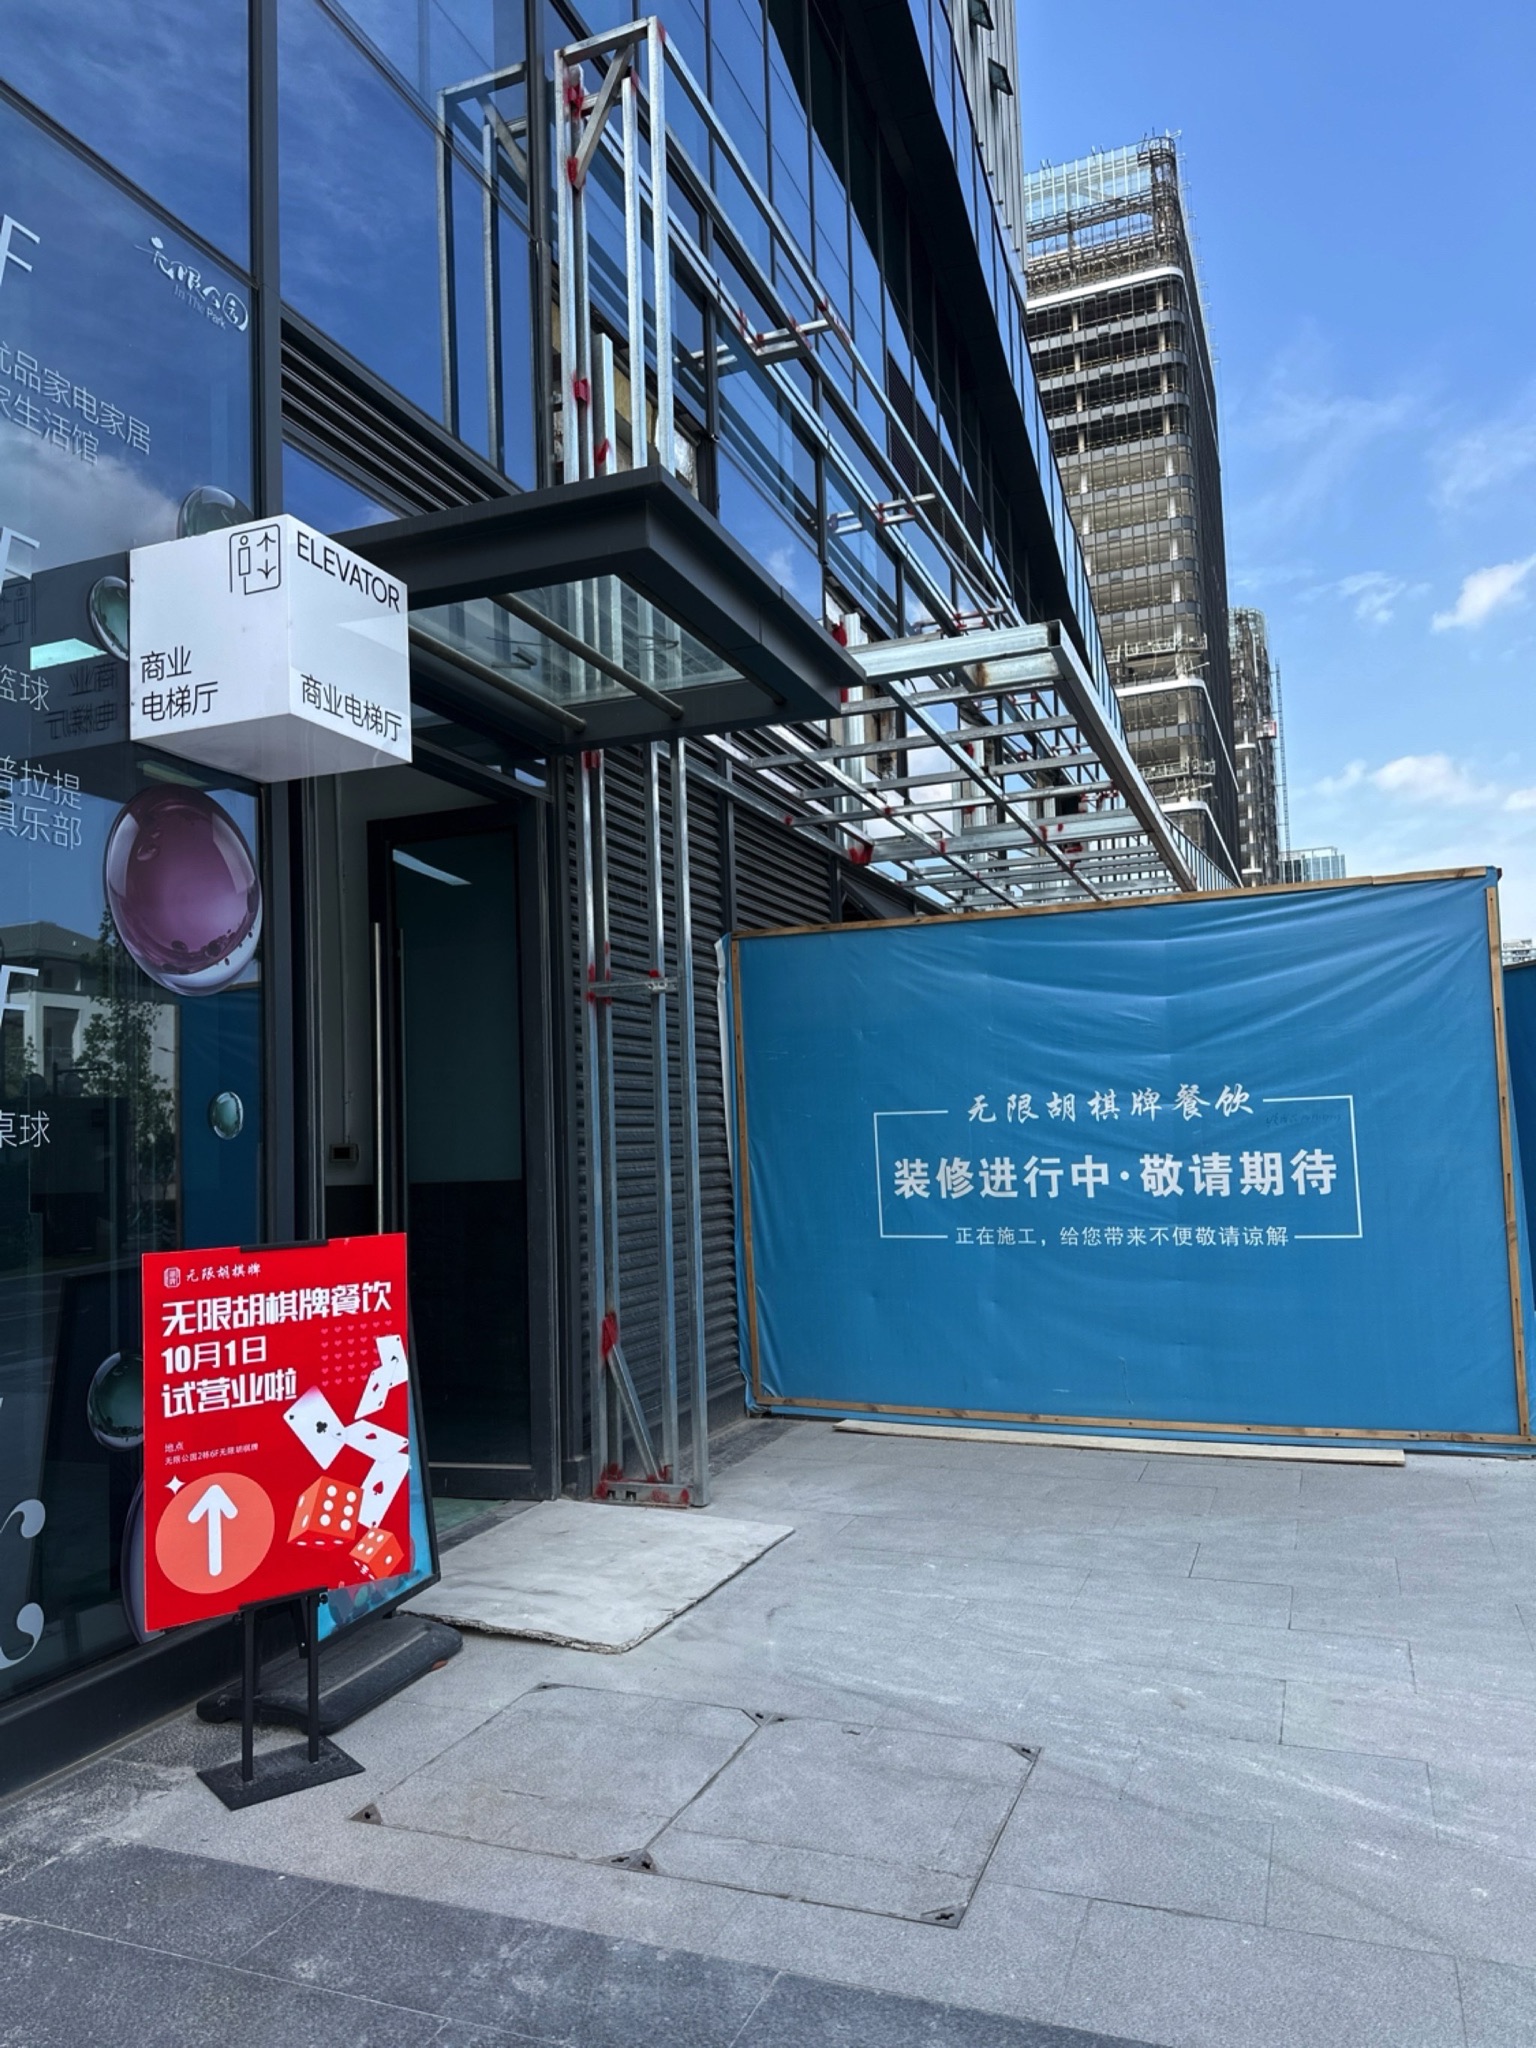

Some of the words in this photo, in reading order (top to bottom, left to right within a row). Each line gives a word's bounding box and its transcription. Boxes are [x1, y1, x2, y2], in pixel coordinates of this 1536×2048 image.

[206, 307, 226, 330] Park
[297, 531, 401, 614] ELEVATOR
[140, 645, 192, 683] 商业
[142, 681, 219, 723] 电梯厅
[300, 673, 402, 743] 商业电梯厅
[967, 1083, 1254, 1124] 无限胡棋牌餐饮
[894, 1148, 1338, 1200] 装修进行中·敬请期待
[955, 1225, 1290, 1248] 正在施工，给您带来不便敬请谅解
[160, 1280, 393, 1338] 无限胡棋牌餐饮
[160, 1335, 268, 1375] 10月1日
[160, 1367, 298, 1419] 试营业啦
[164, 1441, 185, 1453] 地点
